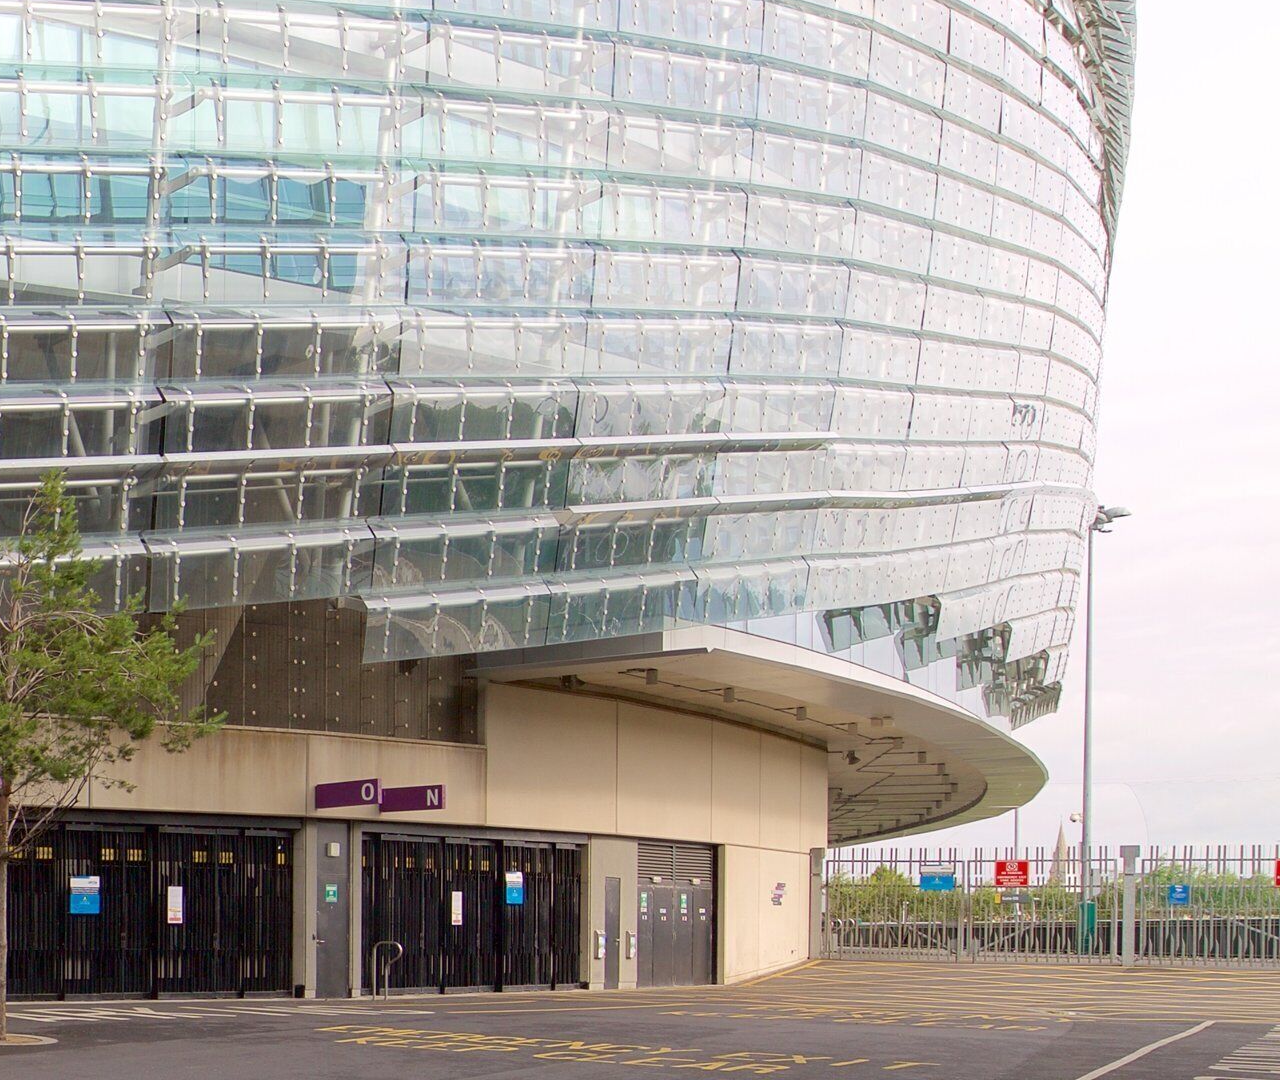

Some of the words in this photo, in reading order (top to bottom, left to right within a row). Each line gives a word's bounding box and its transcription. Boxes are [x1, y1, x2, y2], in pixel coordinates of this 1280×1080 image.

[361, 783, 375, 801] O
[426, 789, 439, 806] N
[316, 1025, 703, 1054] EMERGENCY
[712, 1052, 942, 1070] EXIT
[335, 1036, 520, 1052] KEEP
[533, 1051, 792, 1074] CLEAR
